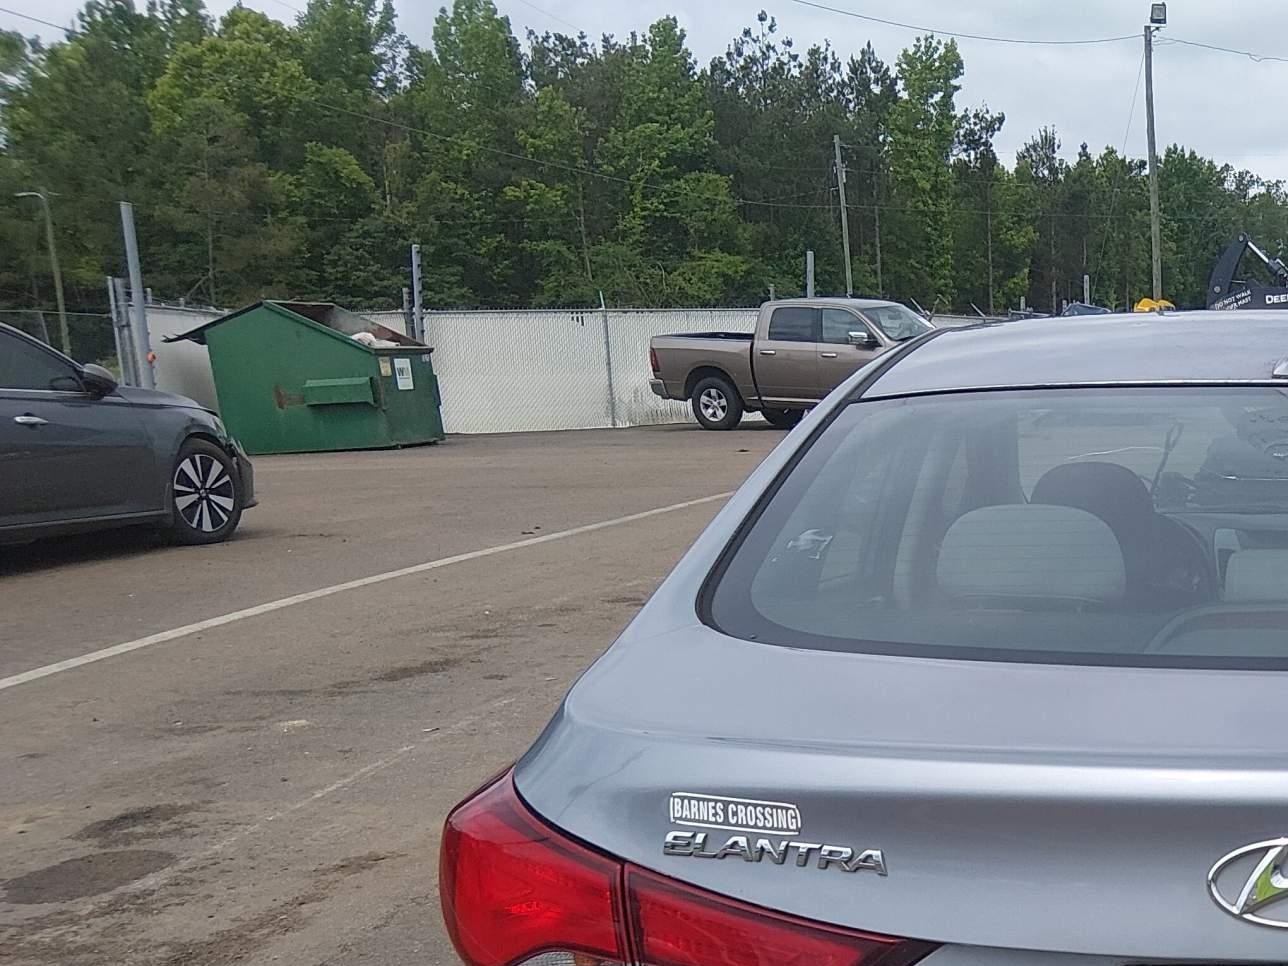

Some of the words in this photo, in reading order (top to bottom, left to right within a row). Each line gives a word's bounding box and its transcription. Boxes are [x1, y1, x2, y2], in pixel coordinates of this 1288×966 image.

[674, 798, 724, 823] BARNES
[728, 804, 797, 830] CROSSING
[663, 831, 888, 877] ELANTRA
